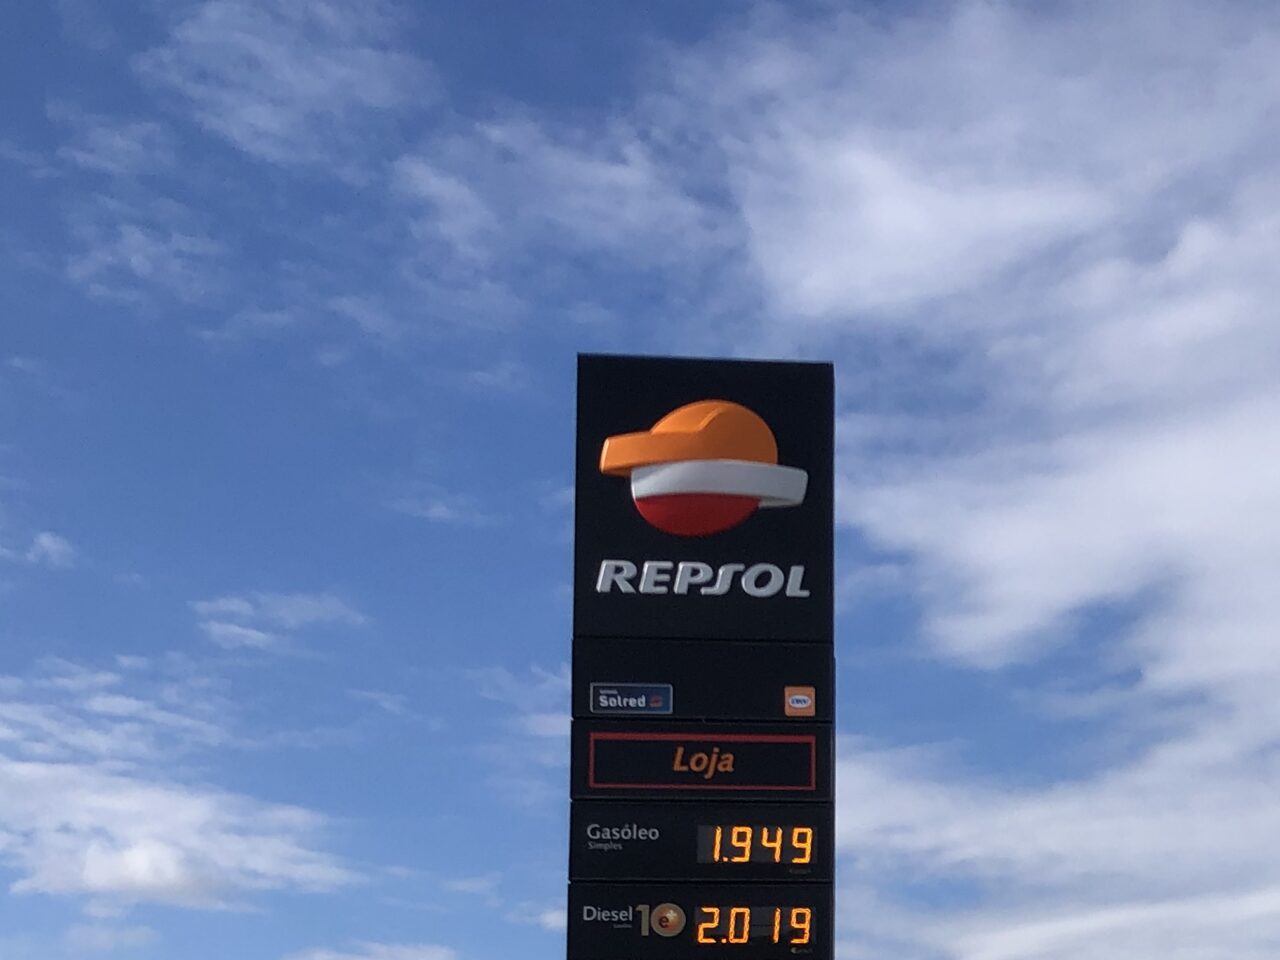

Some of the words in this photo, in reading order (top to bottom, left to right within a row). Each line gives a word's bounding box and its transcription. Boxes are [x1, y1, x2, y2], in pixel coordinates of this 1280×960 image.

[596, 559, 811, 598] REPSOL
[599, 695, 646, 708] Solred
[672, 746, 735, 780] Loja
[586, 823, 660, 841] Gasóleo
[712, 825, 813, 864] 1.949
[583, 905, 633, 922] Diesel
[696, 906, 813, 944] 2.019
